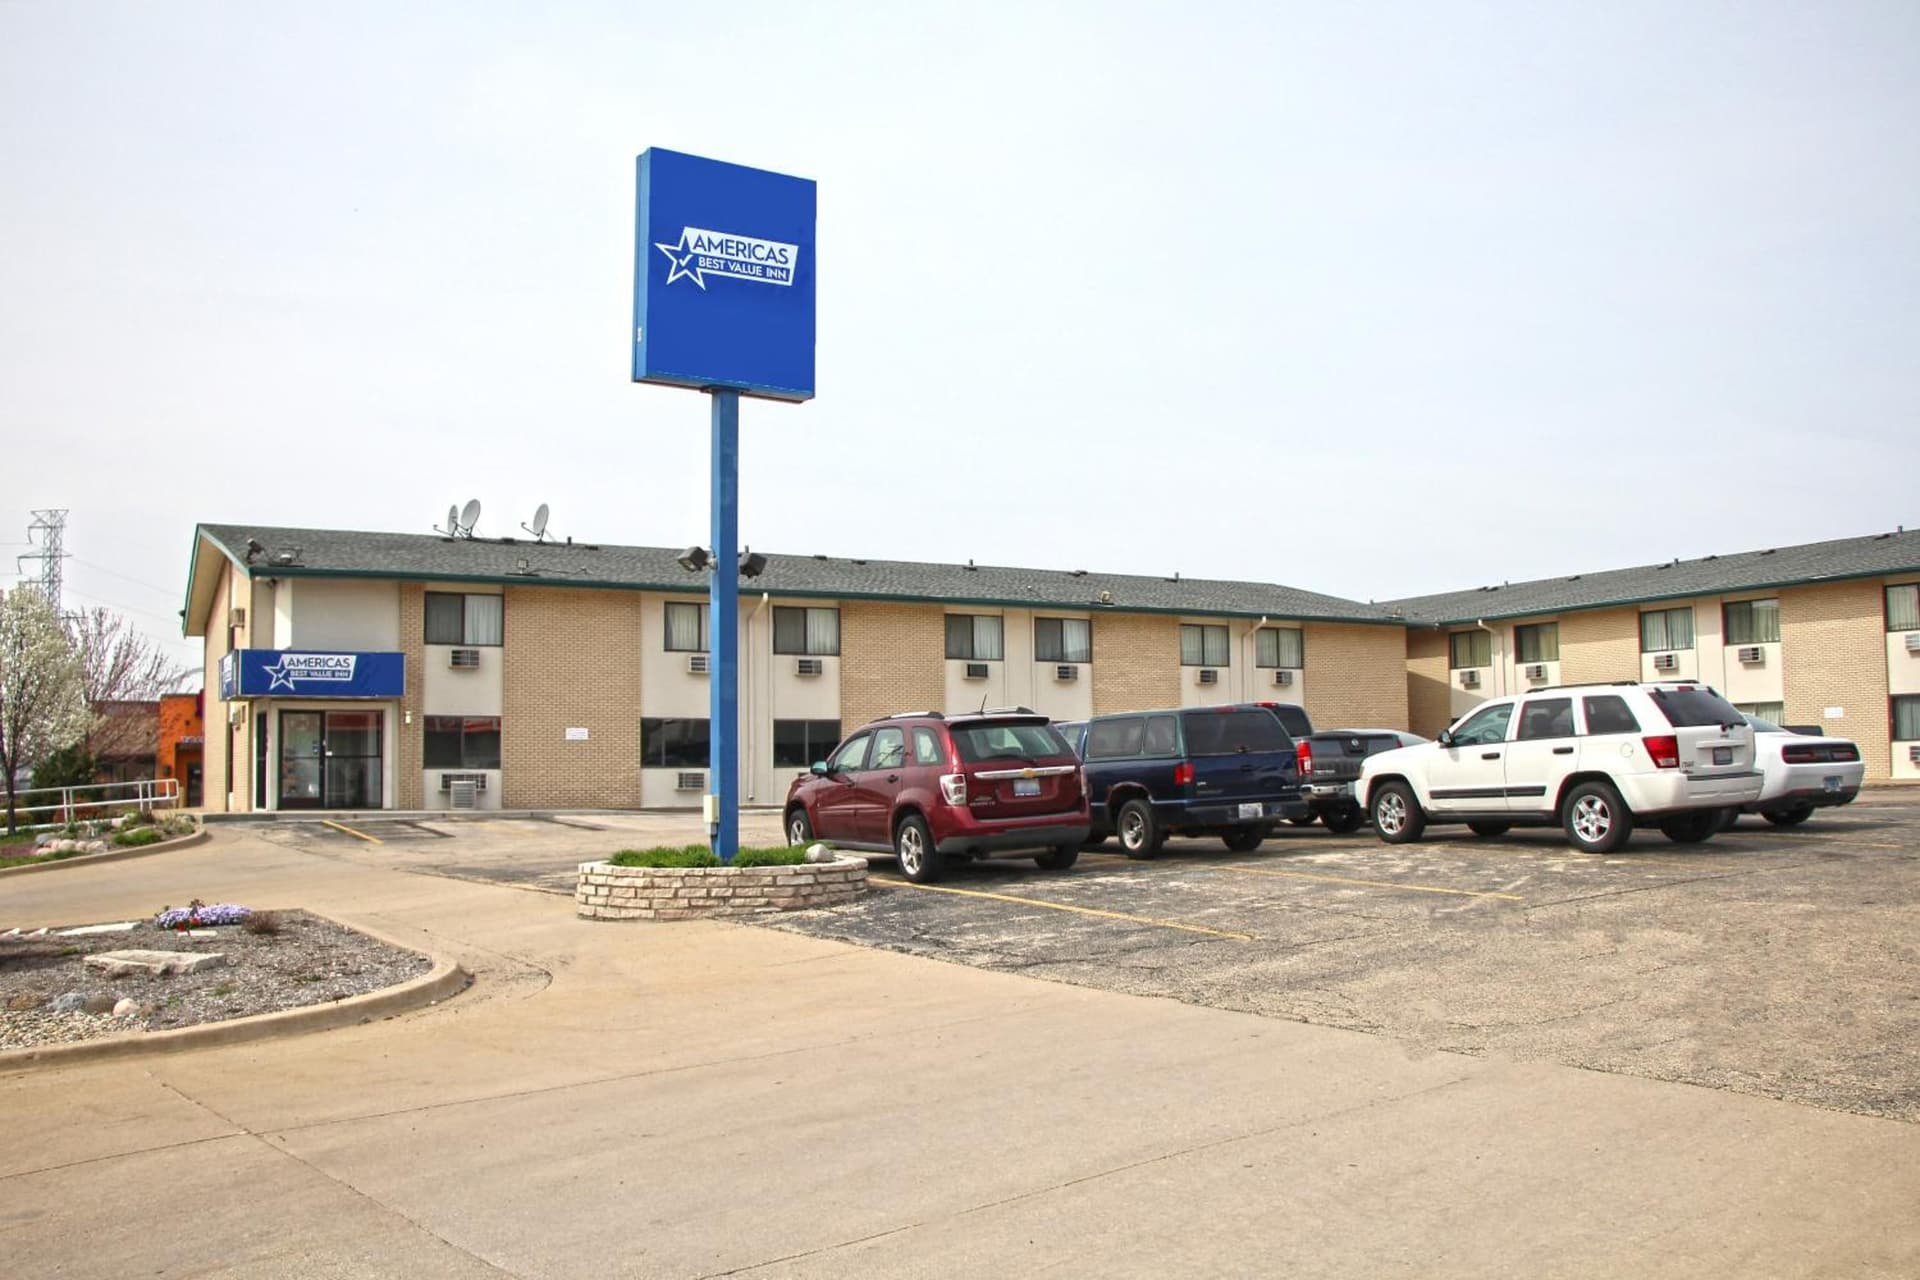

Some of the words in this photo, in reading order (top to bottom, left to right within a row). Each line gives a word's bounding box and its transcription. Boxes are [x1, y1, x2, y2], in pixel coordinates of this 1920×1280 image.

[692, 234, 788, 264] AMERICAS
[698, 256, 725, 270] BEST
[727, 261, 762, 276] VALUE
[766, 268, 787, 280] INN
[287, 657, 350, 668] AMERICAS
[290, 670, 308, 678] BEST
